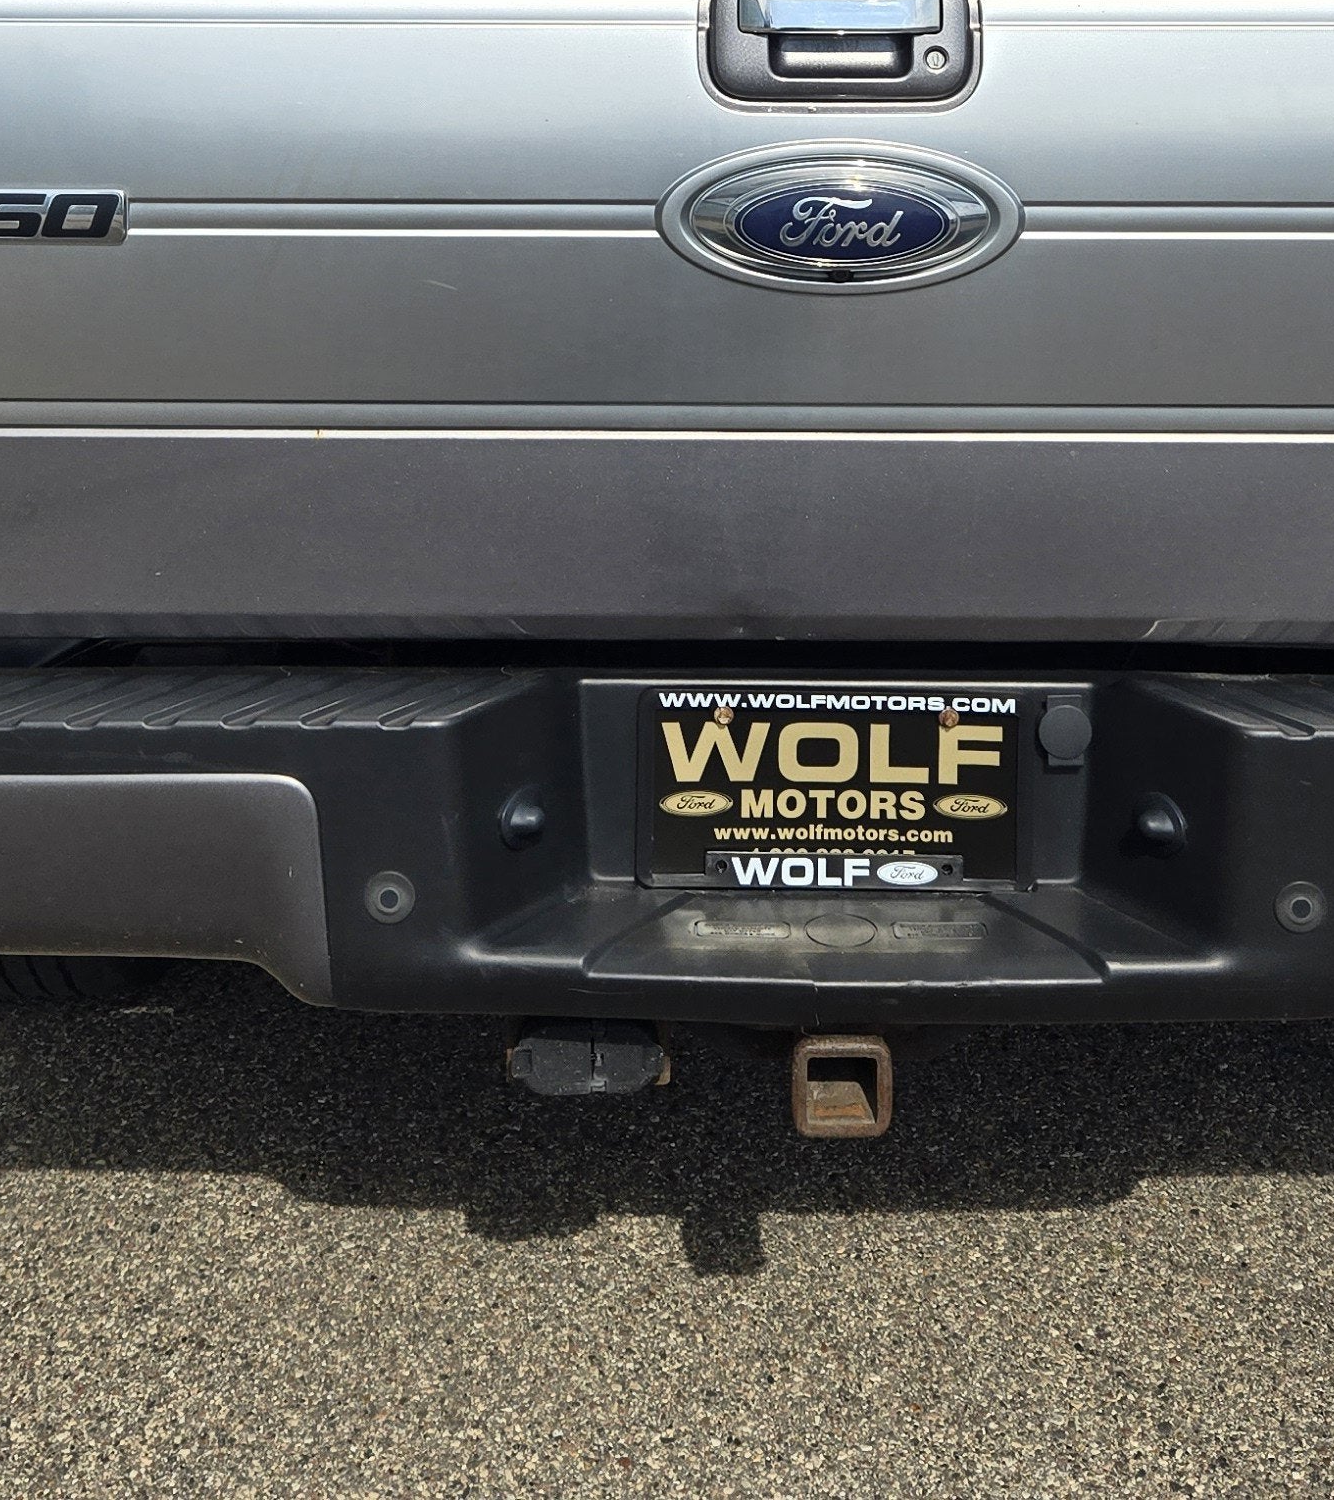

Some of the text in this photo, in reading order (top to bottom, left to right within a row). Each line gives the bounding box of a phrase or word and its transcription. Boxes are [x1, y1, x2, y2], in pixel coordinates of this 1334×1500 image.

[779, 196, 904, 247] Ford
[659, 692, 1016, 713] WWW.WOLFMOTORS.COM
[661, 721, 1004, 785] WOLF
[676, 793, 717, 811] Ford
[740, 789, 926, 821] MOTORS
[949, 797, 991, 814] Ford
[713, 824, 953, 843] www.wolfmotors.com
[731, 856, 925, 887] WOLF Ford
